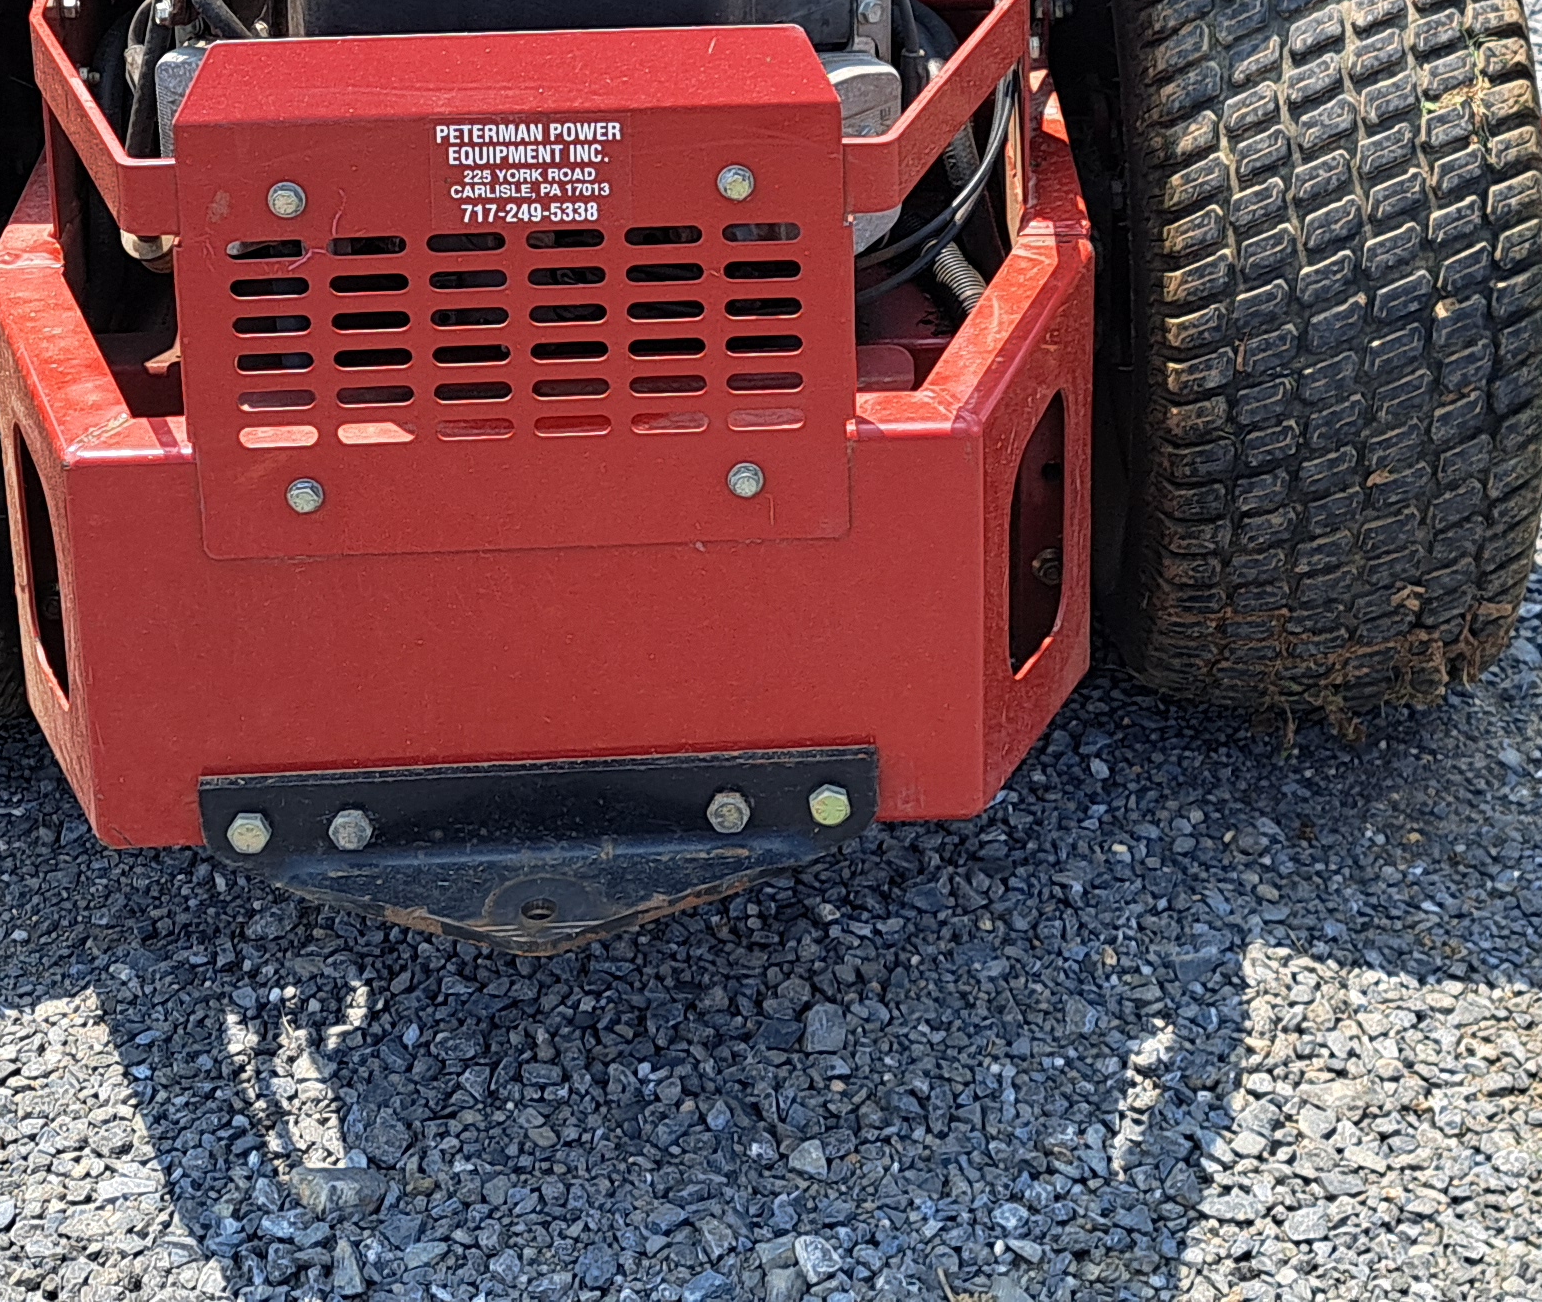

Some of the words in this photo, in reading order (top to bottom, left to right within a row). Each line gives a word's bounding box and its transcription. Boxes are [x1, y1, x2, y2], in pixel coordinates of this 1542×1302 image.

[435, 123, 543, 144] PETERMAN
[549, 122, 622, 141] POWER
[448, 144, 564, 166] EQUIPMENT
[569, 144, 610, 163] INC.
[463, 169, 491, 183] 225
[495, 168, 544, 182] YORK
[547, 168, 596, 181] ROAD
[450, 184, 536, 200] CARLISLE,
[540, 184, 561, 197] PA
[566, 183, 610, 196] 17013
[460, 202, 598, 223] 717-249-5338
